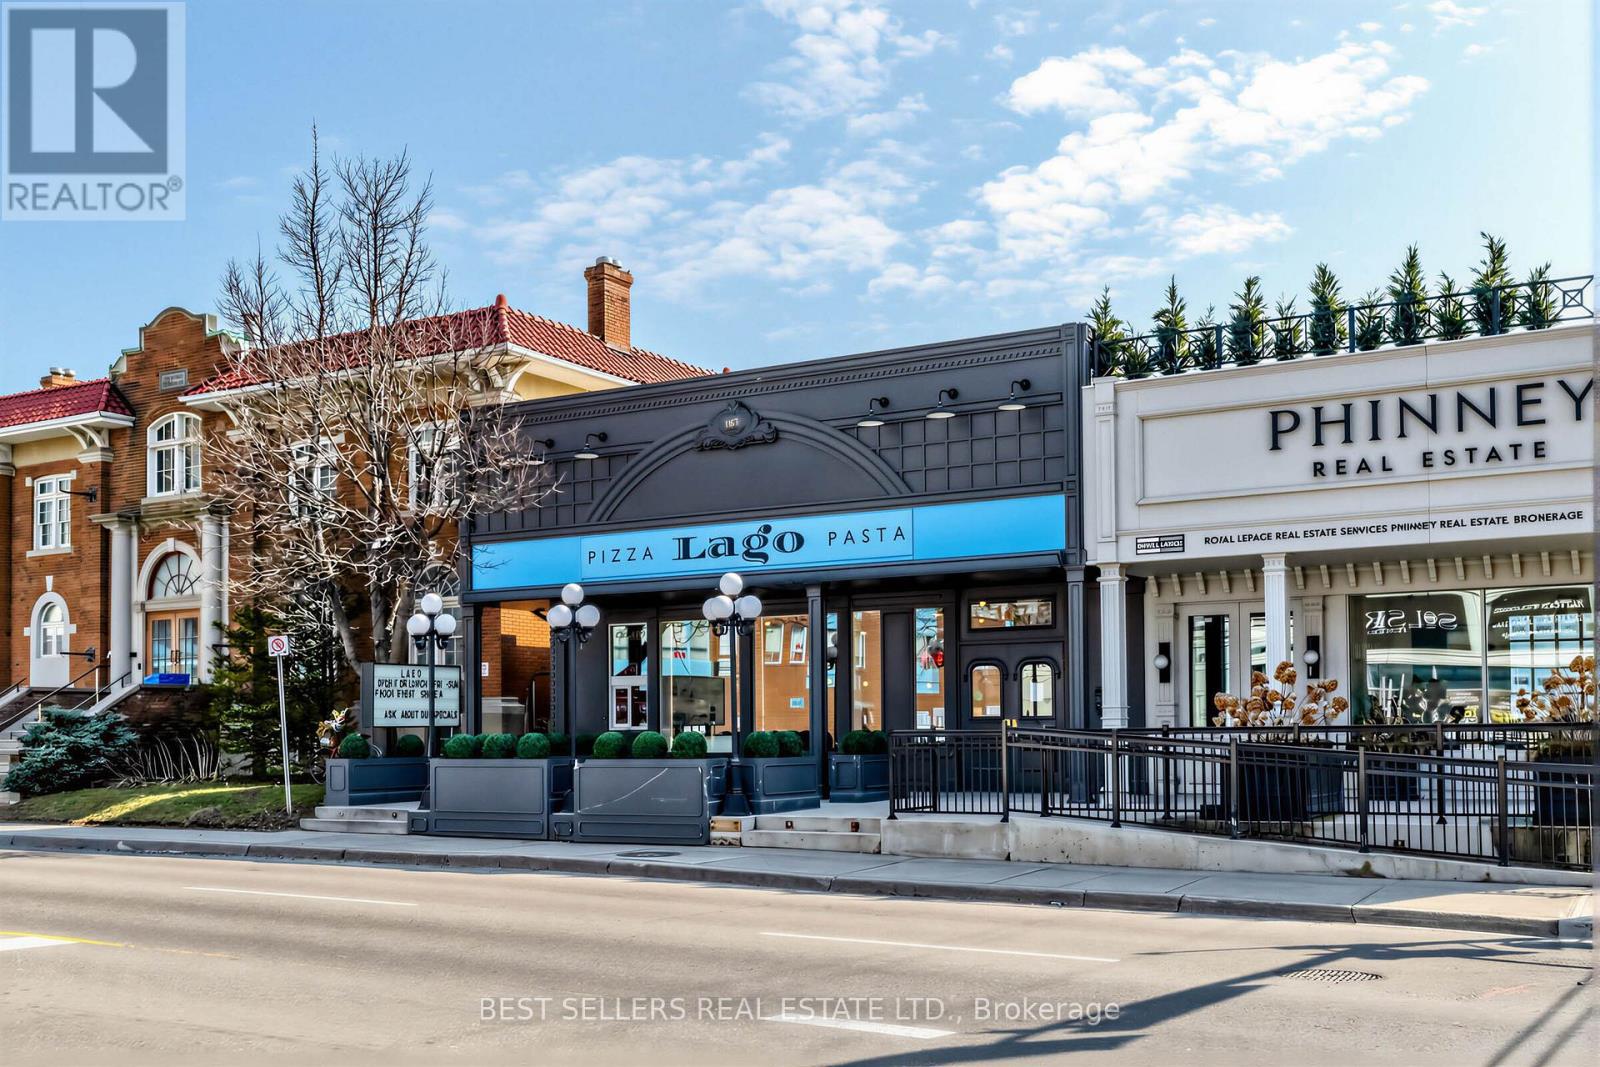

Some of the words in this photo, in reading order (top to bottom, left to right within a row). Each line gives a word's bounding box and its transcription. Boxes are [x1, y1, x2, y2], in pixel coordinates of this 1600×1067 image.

[1269, 379, 1594, 450] PHINNEY
[1313, 456, 1393, 477] REAL
[1423, 441, 1547, 468] ESTATE
[587, 546, 654, 564] PIZZA
[671, 523, 805, 565] Lago
[827, 526, 906, 546] PASTA
[1276, 530, 1301, 540] REAL
[1303, 527, 1338, 538] ESTATE
[1440, 517, 1467, 529] REAL
[384, 710, 396, 719] ASK
